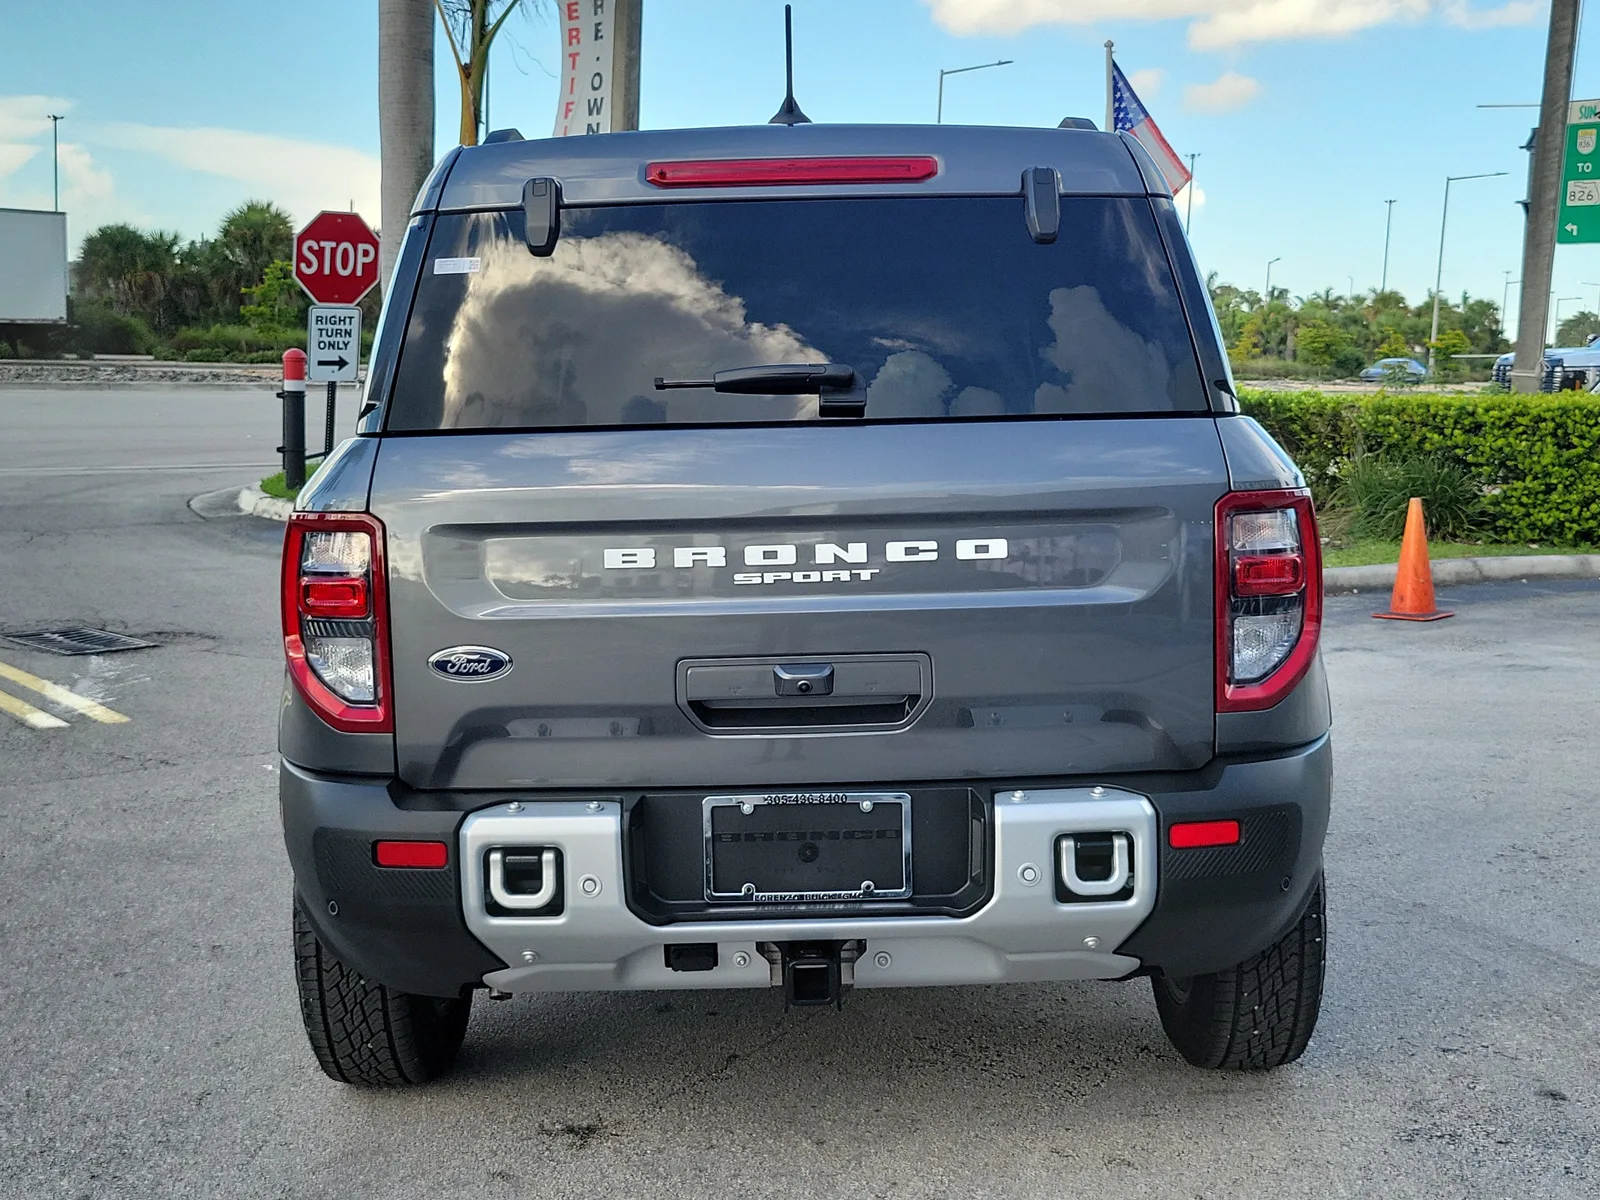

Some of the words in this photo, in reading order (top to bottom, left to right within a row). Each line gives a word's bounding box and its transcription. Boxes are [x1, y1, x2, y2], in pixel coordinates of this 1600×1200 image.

[1577, 162, 1593, 173] TO
[1568, 190, 1594, 202] 826
[300, 239, 376, 277] STOP
[315, 315, 355, 326] RIGHT
[317, 328, 352, 338] TURN
[317, 340, 351, 351] ONLY
[603, 538, 1009, 569] BRONCO
[733, 569, 879, 585] SPORT
[447, 653, 492, 673] Ford
[766, 793, 848, 805] 305-436-8400
[714, 829, 900, 843] BRONCO
[755, 893, 799, 902] LORENZO
[804, 892, 836, 901] BUICK
